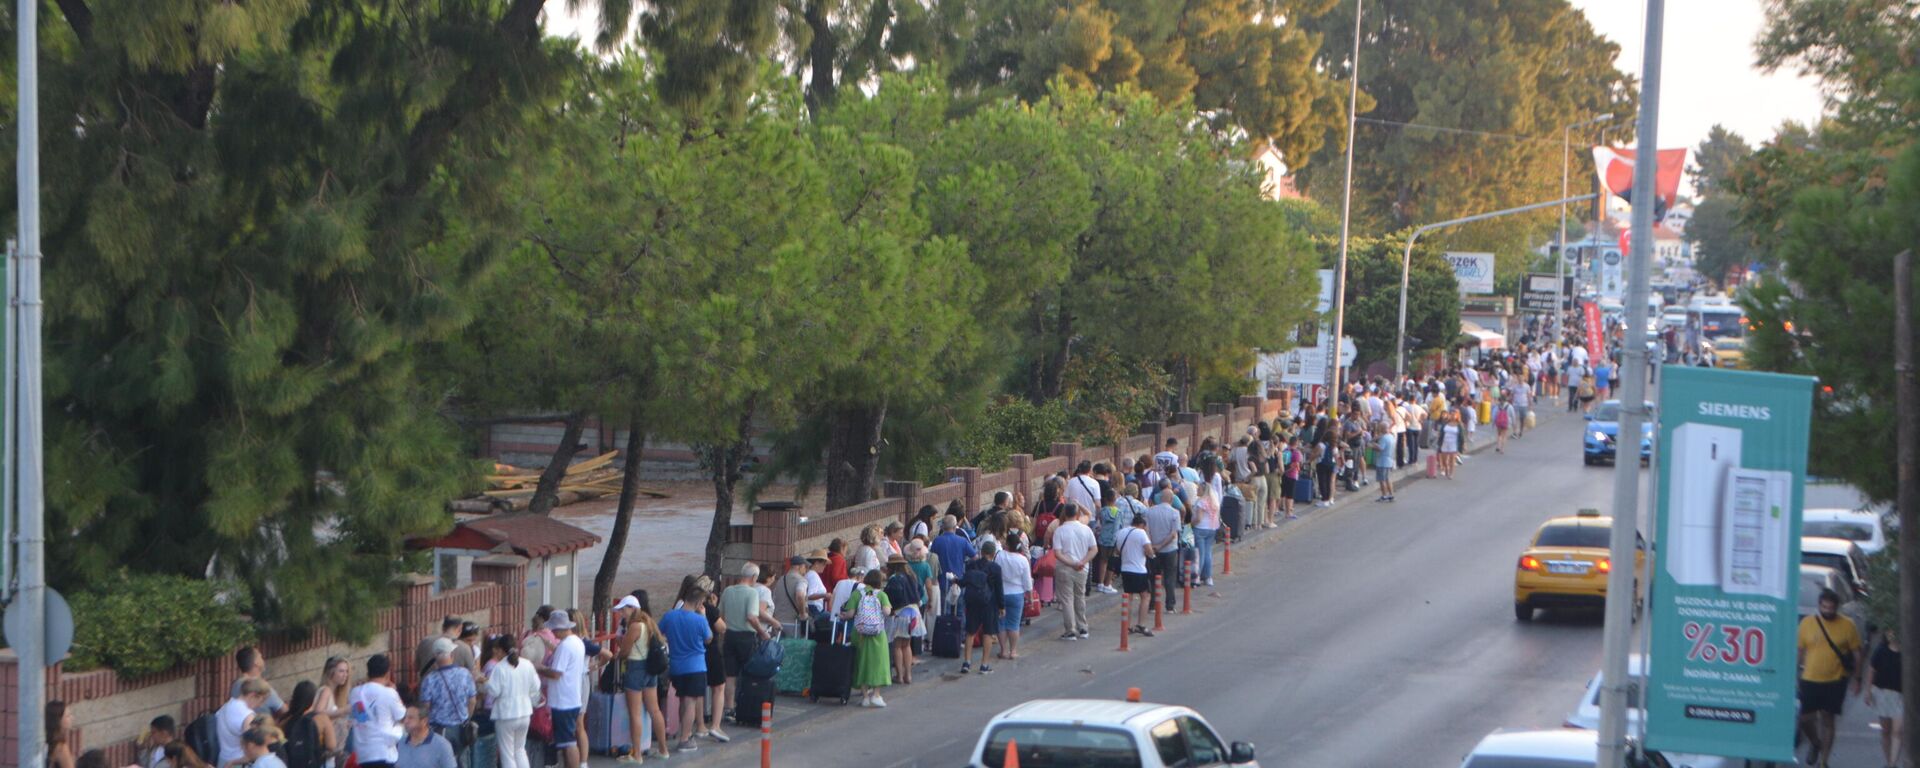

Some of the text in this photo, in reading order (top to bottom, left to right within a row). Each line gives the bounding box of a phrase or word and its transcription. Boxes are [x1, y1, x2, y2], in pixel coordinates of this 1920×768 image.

[1698, 401, 1771, 421] SIEMENS
[1674, 596, 1730, 609] BUZDOLABI
[1678, 606, 1772, 623] DONDURUCULARDA
[1683, 621, 1766, 666] %30
[1722, 671, 1761, 684] ZAMANI
